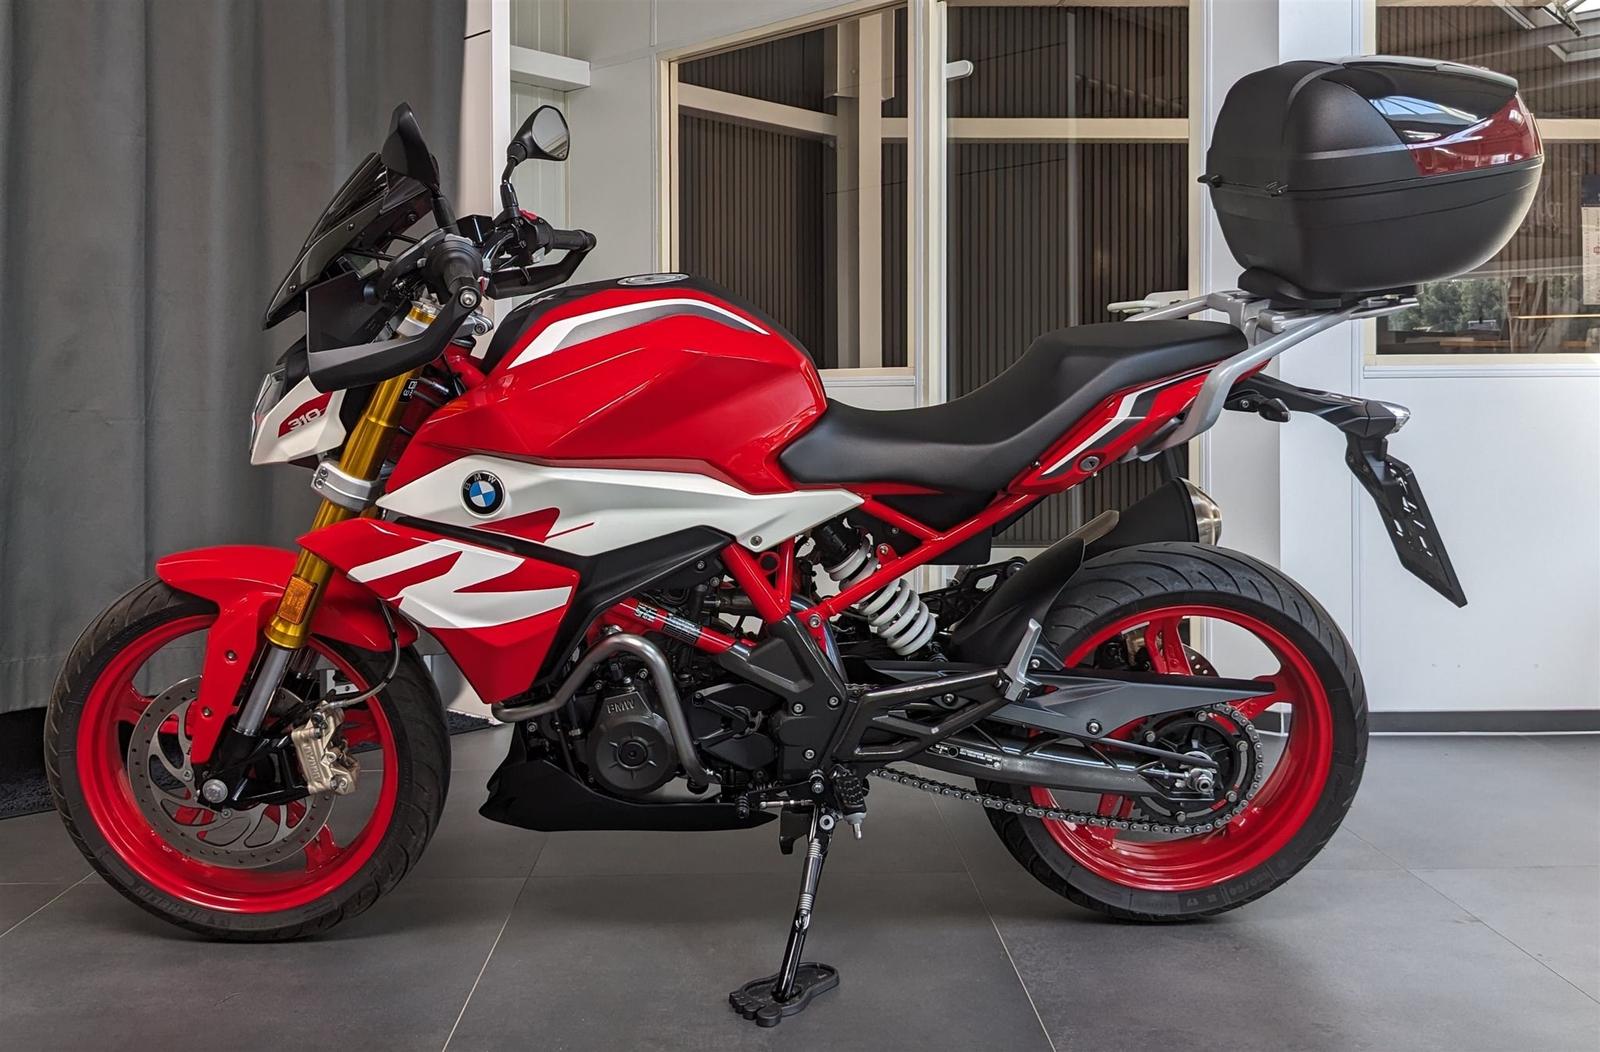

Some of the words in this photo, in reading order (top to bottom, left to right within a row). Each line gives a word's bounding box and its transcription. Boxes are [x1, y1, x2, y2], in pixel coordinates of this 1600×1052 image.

[288, 409, 321, 430] 310
[463, 472, 497, 490] BMW
[607, 699, 635, 714] BMW
